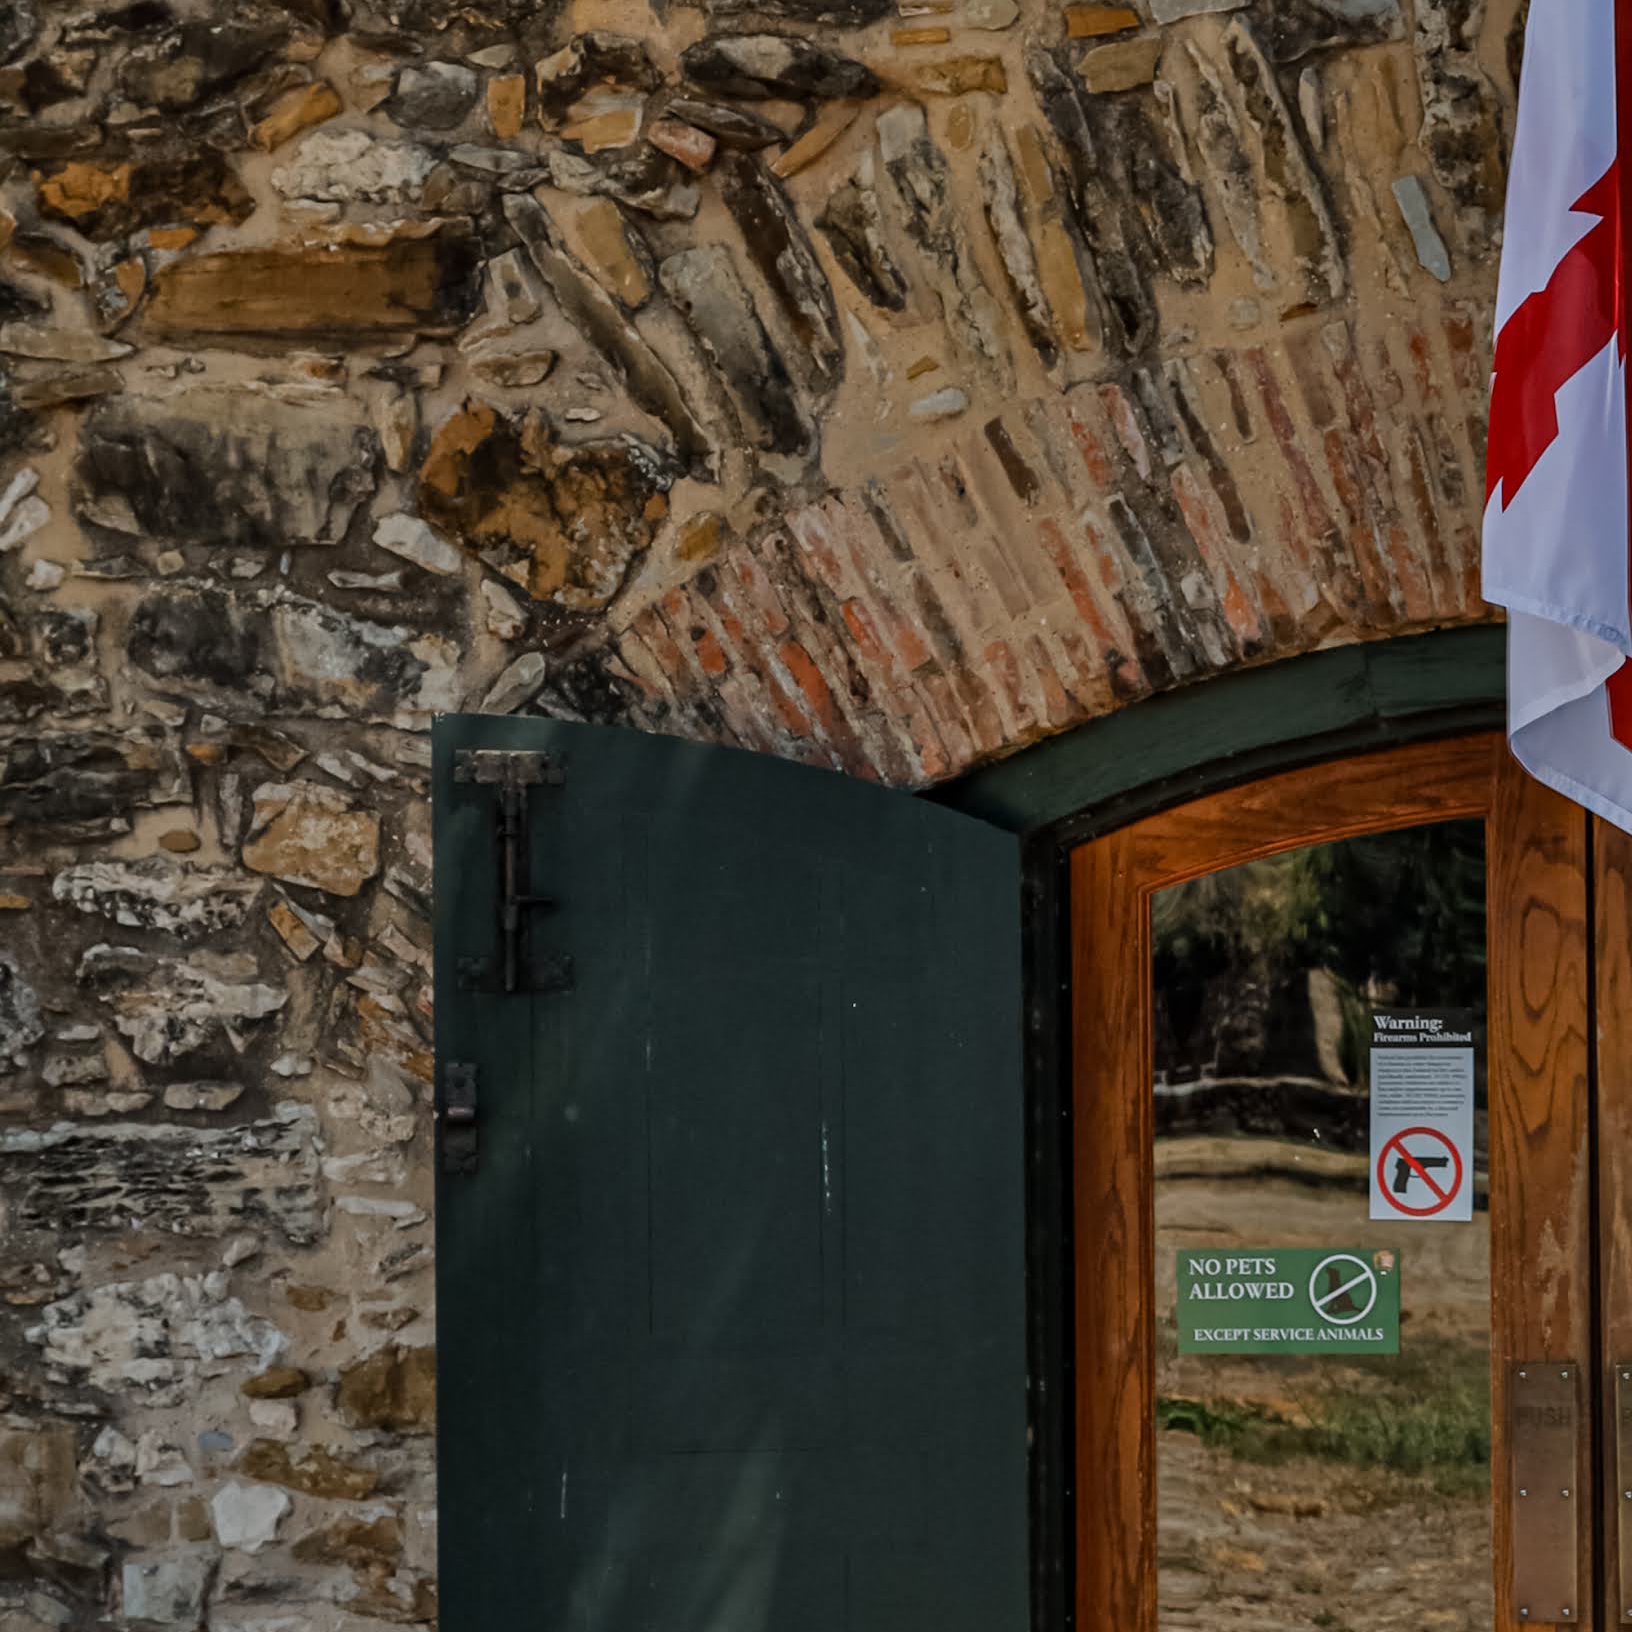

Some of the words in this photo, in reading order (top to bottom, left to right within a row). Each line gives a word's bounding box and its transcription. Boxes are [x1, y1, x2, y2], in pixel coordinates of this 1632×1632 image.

[1373, 1015, 1443, 1032] Warning:
[1373, 1032, 1418, 1042] Firearms
[1419, 1032, 1472, 1042] Prohibited
[1189, 1258, 1221, 1275] NO
[1226, 1258, 1276, 1275] PETS
[1189, 1282, 1295, 1299] ALLOWED
[1194, 1328, 1251, 1341] EXCEPT
[1253, 1328, 1314, 1341] SERVICE
[1316, 1327, 1384, 1341] ANIMALS
[1515, 1406, 1571, 1427] PUSH
